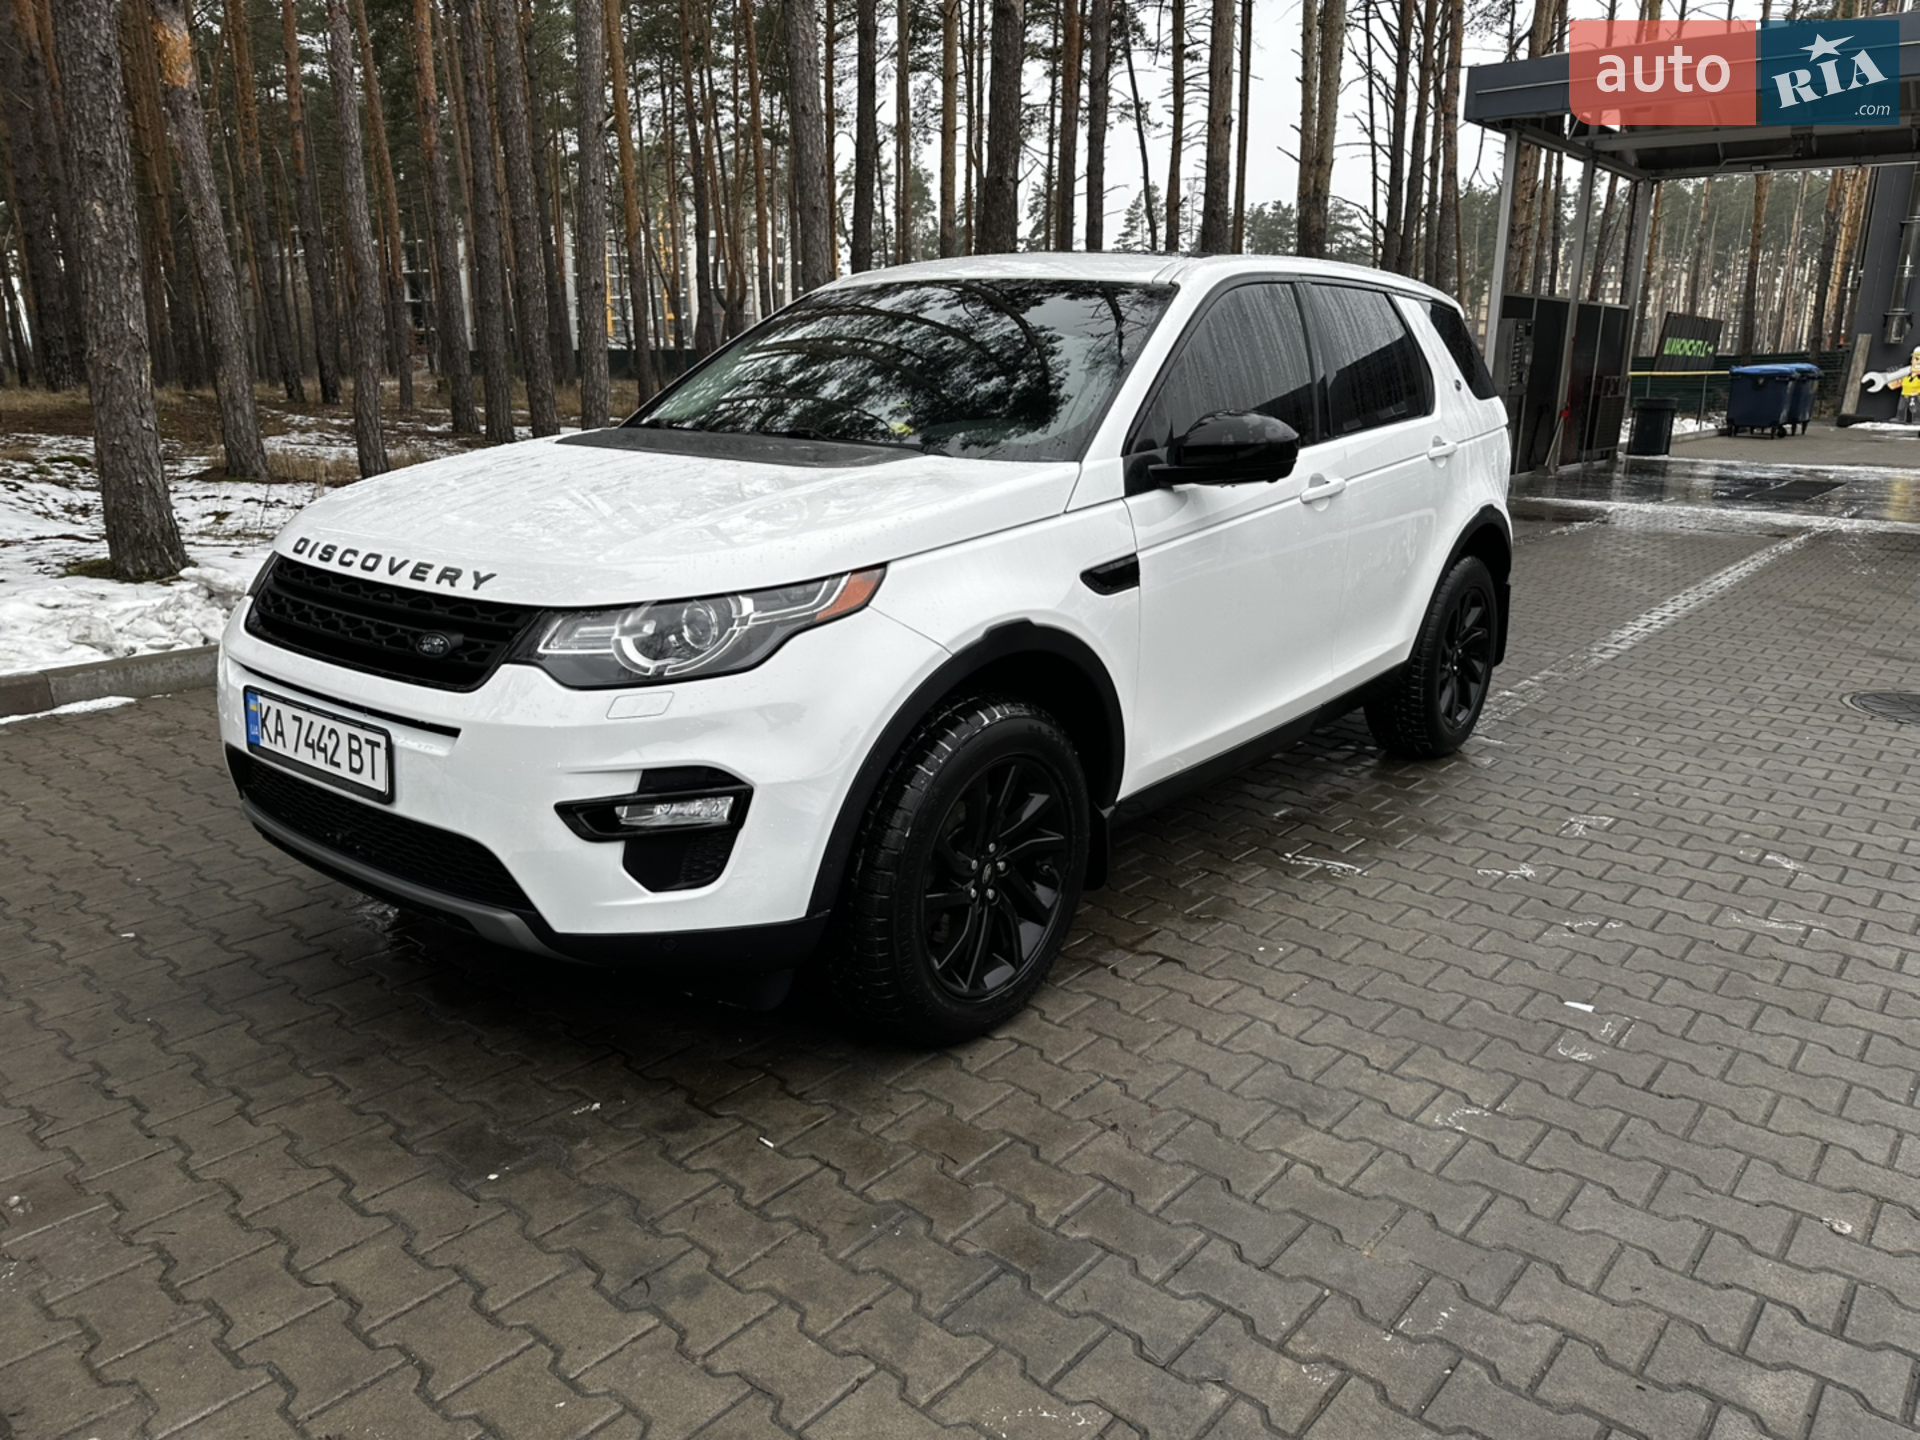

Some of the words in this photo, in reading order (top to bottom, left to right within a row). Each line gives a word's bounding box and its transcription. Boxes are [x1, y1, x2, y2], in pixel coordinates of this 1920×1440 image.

[292, 536, 498, 591] DISCOVERY
[259, 702, 287, 749] KA
[291, 714, 342, 770] 7442
[347, 732, 382, 782] BT
